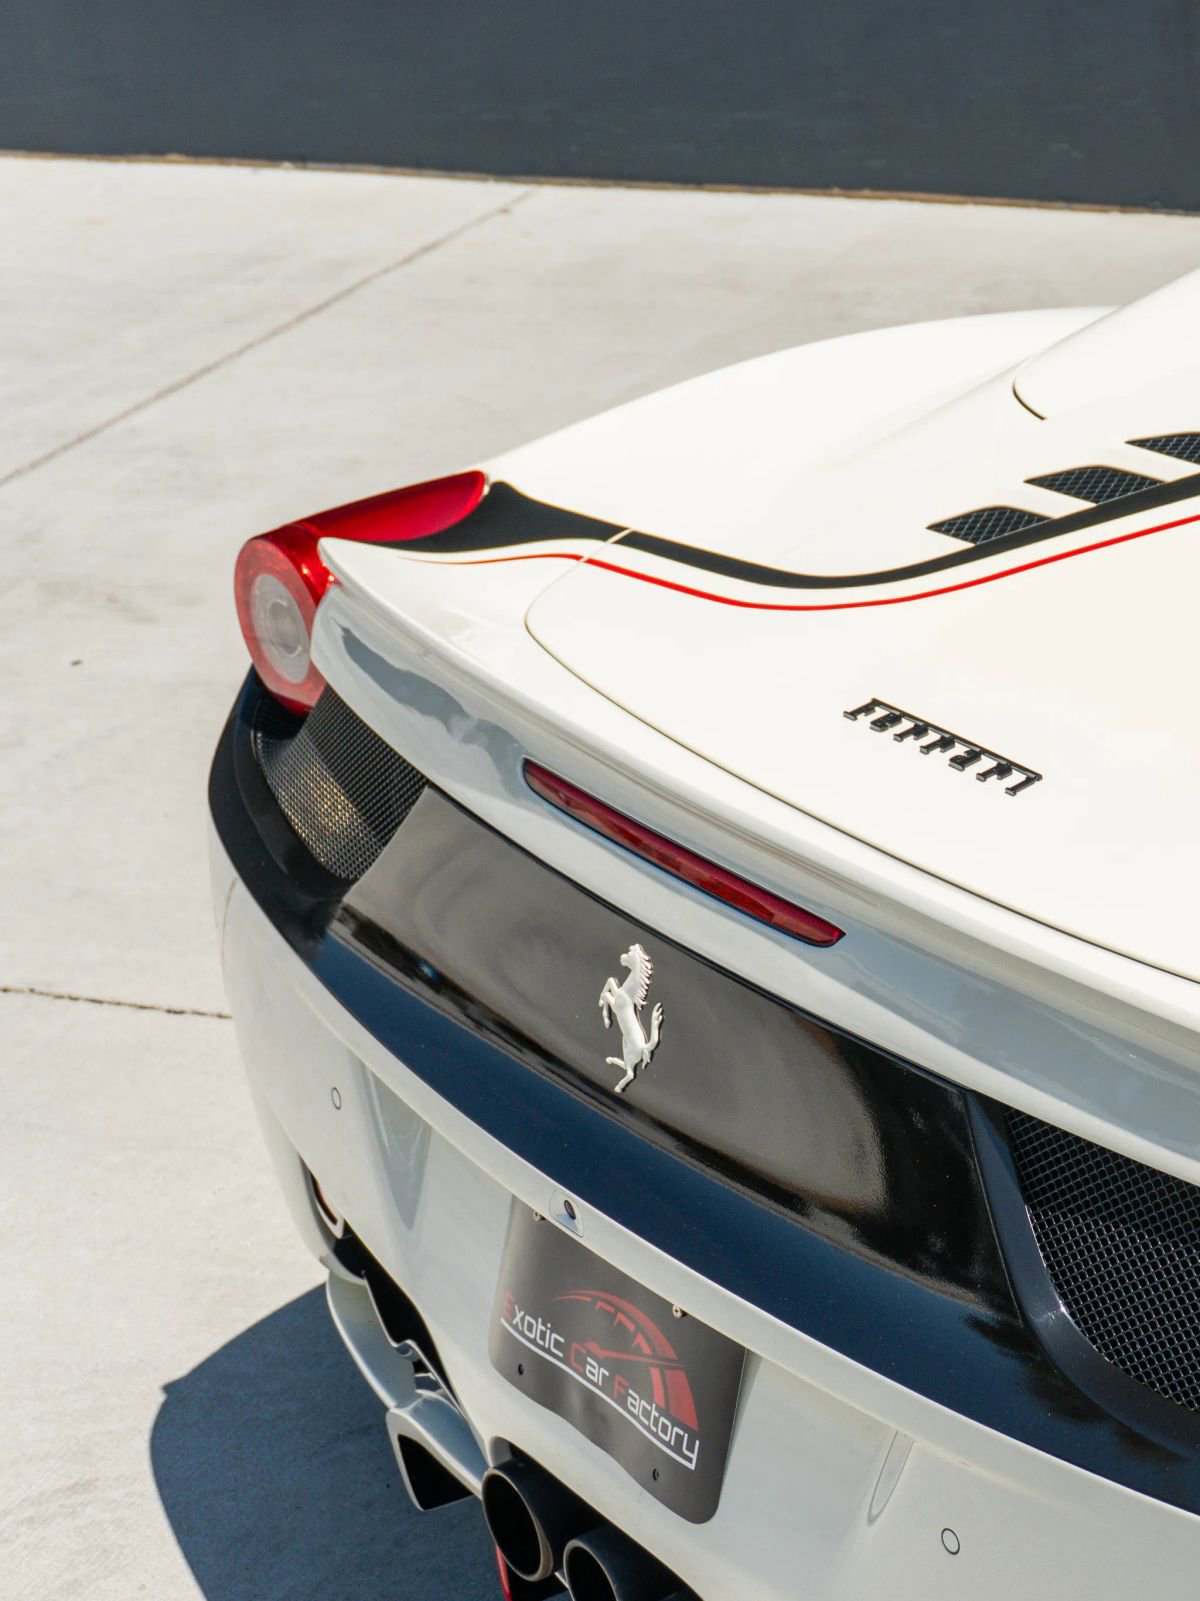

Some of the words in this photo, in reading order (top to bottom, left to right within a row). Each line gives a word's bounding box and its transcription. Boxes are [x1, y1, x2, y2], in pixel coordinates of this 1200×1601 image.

[843, 698, 1042, 796] Ferrari
[503, 1291, 565, 1358] Exotic
[571, 1343, 609, 1386] Car
[614, 1375, 700, 1467] Factory
